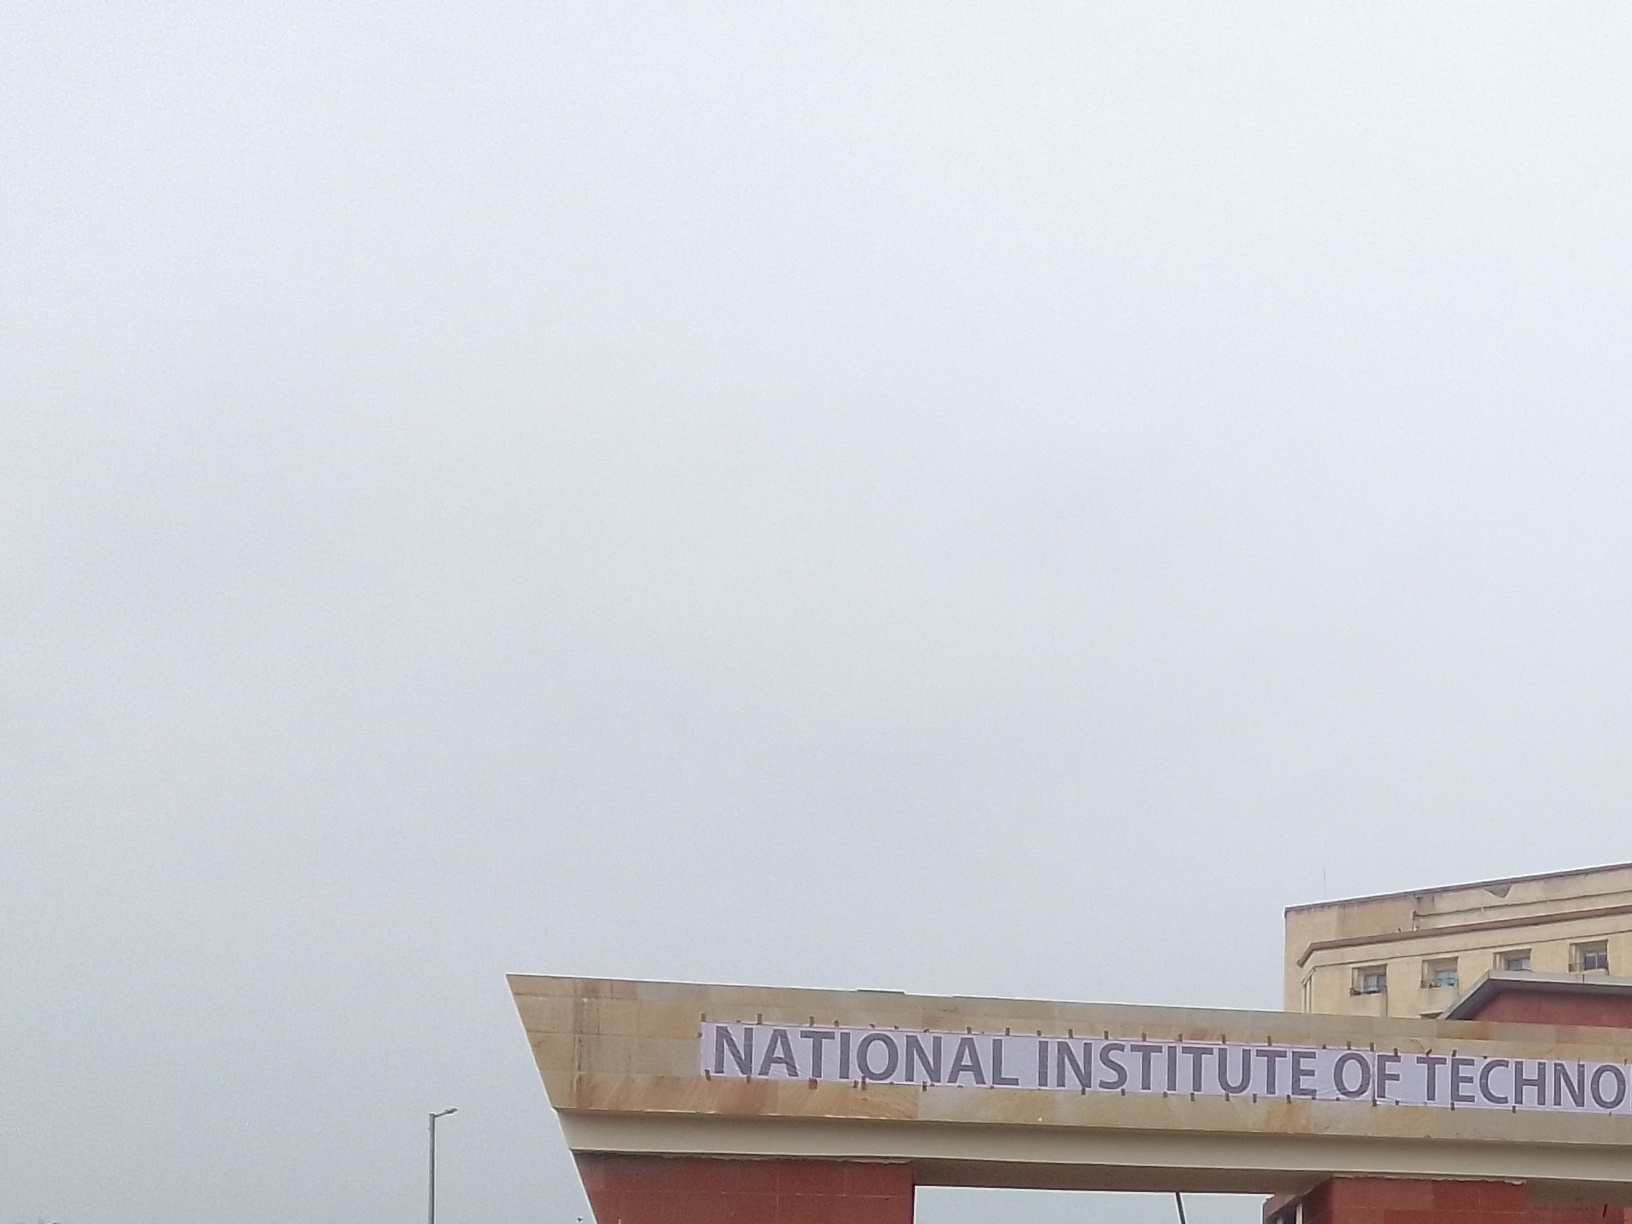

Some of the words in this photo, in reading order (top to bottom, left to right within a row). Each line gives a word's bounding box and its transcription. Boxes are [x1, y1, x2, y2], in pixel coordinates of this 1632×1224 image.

[713, 1024, 1019, 1086] NATIONAL
[1038, 1039, 1318, 1097] INSTITUTE
[1333, 1051, 1401, 1099] OF
